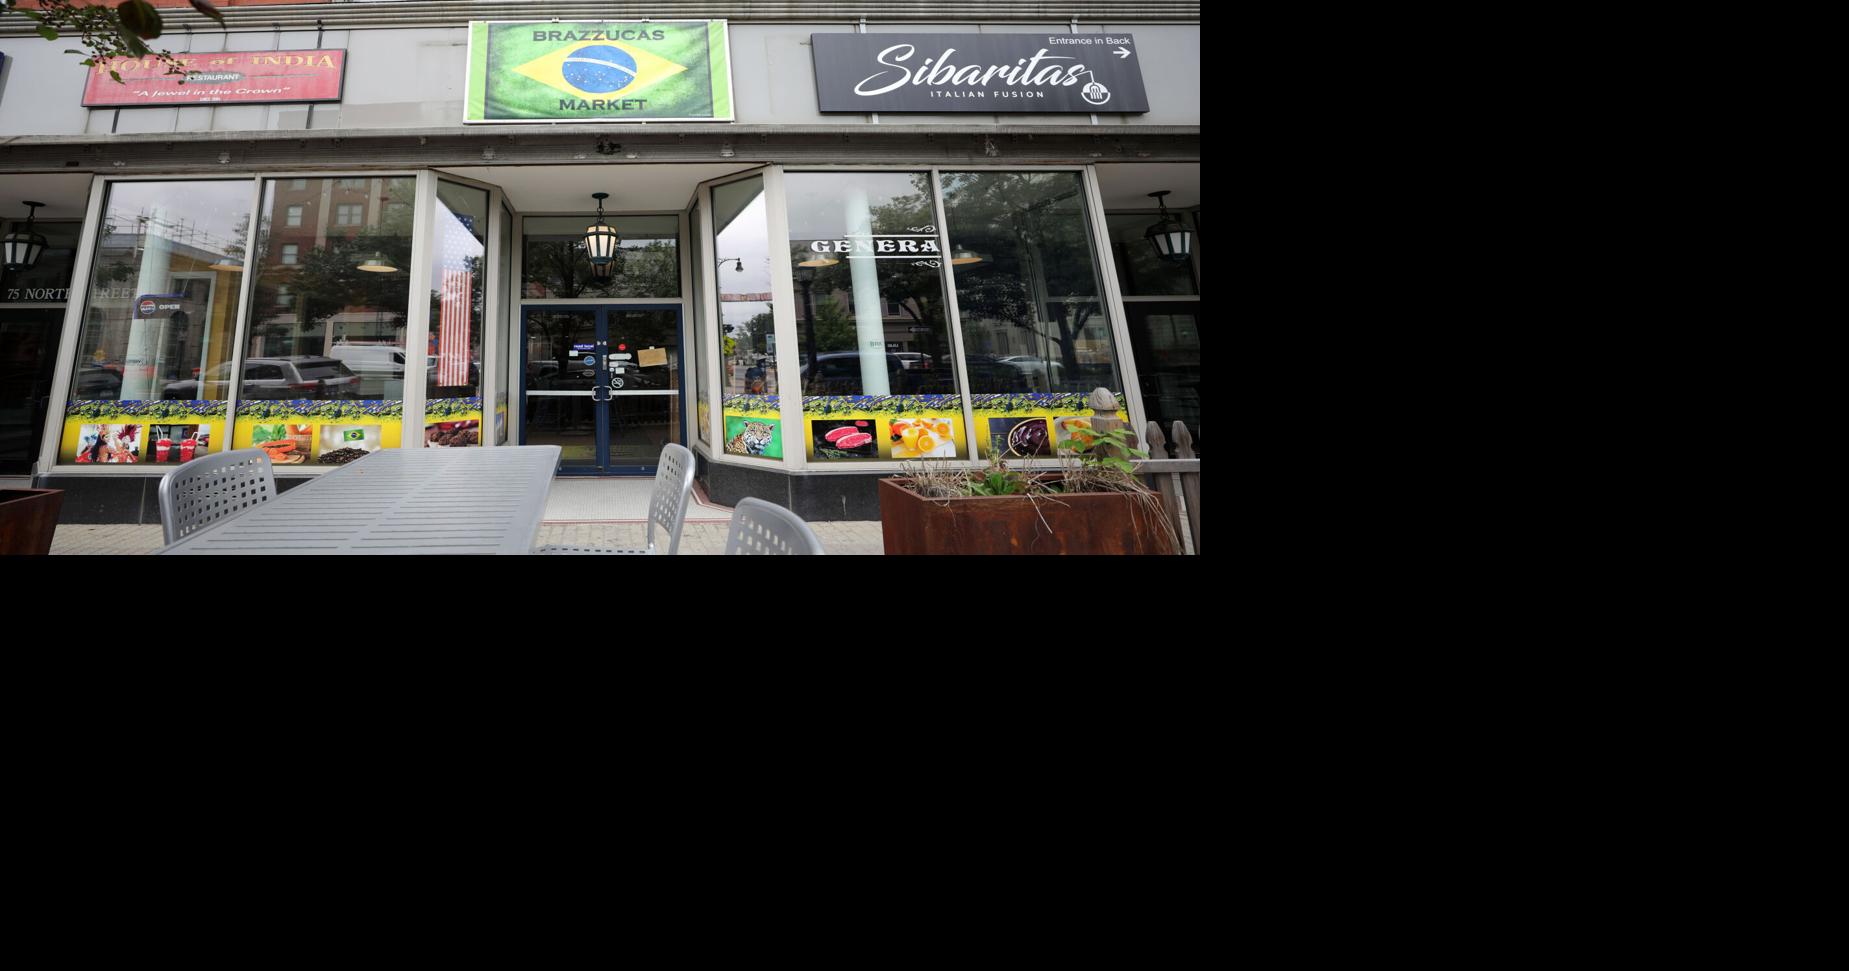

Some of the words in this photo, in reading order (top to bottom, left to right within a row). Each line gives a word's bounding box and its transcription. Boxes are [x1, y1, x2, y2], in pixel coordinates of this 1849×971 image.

[532, 29, 665, 42] BRAZZUCAS
[1048, 36, 1093, 45] Entrance
[1095, 36, 1104, 45] in
[1105, 36, 1131, 45] Back
[252, 54, 336, 69] INDIA
[853, 43, 1088, 97] Sibaritas
[186, 73, 240, 82] RESTAURANT
[151, 88, 190, 97] Jewel
[193, 88, 205, 96] in
[207, 87, 232, 96] the
[930, 90, 985, 98] ITALIAN
[994, 90, 1044, 98] FUSION
[558, 98, 648, 111] MARKET
[810, 239, 941, 254] GENERA
[8, 288, 20, 300] 75
